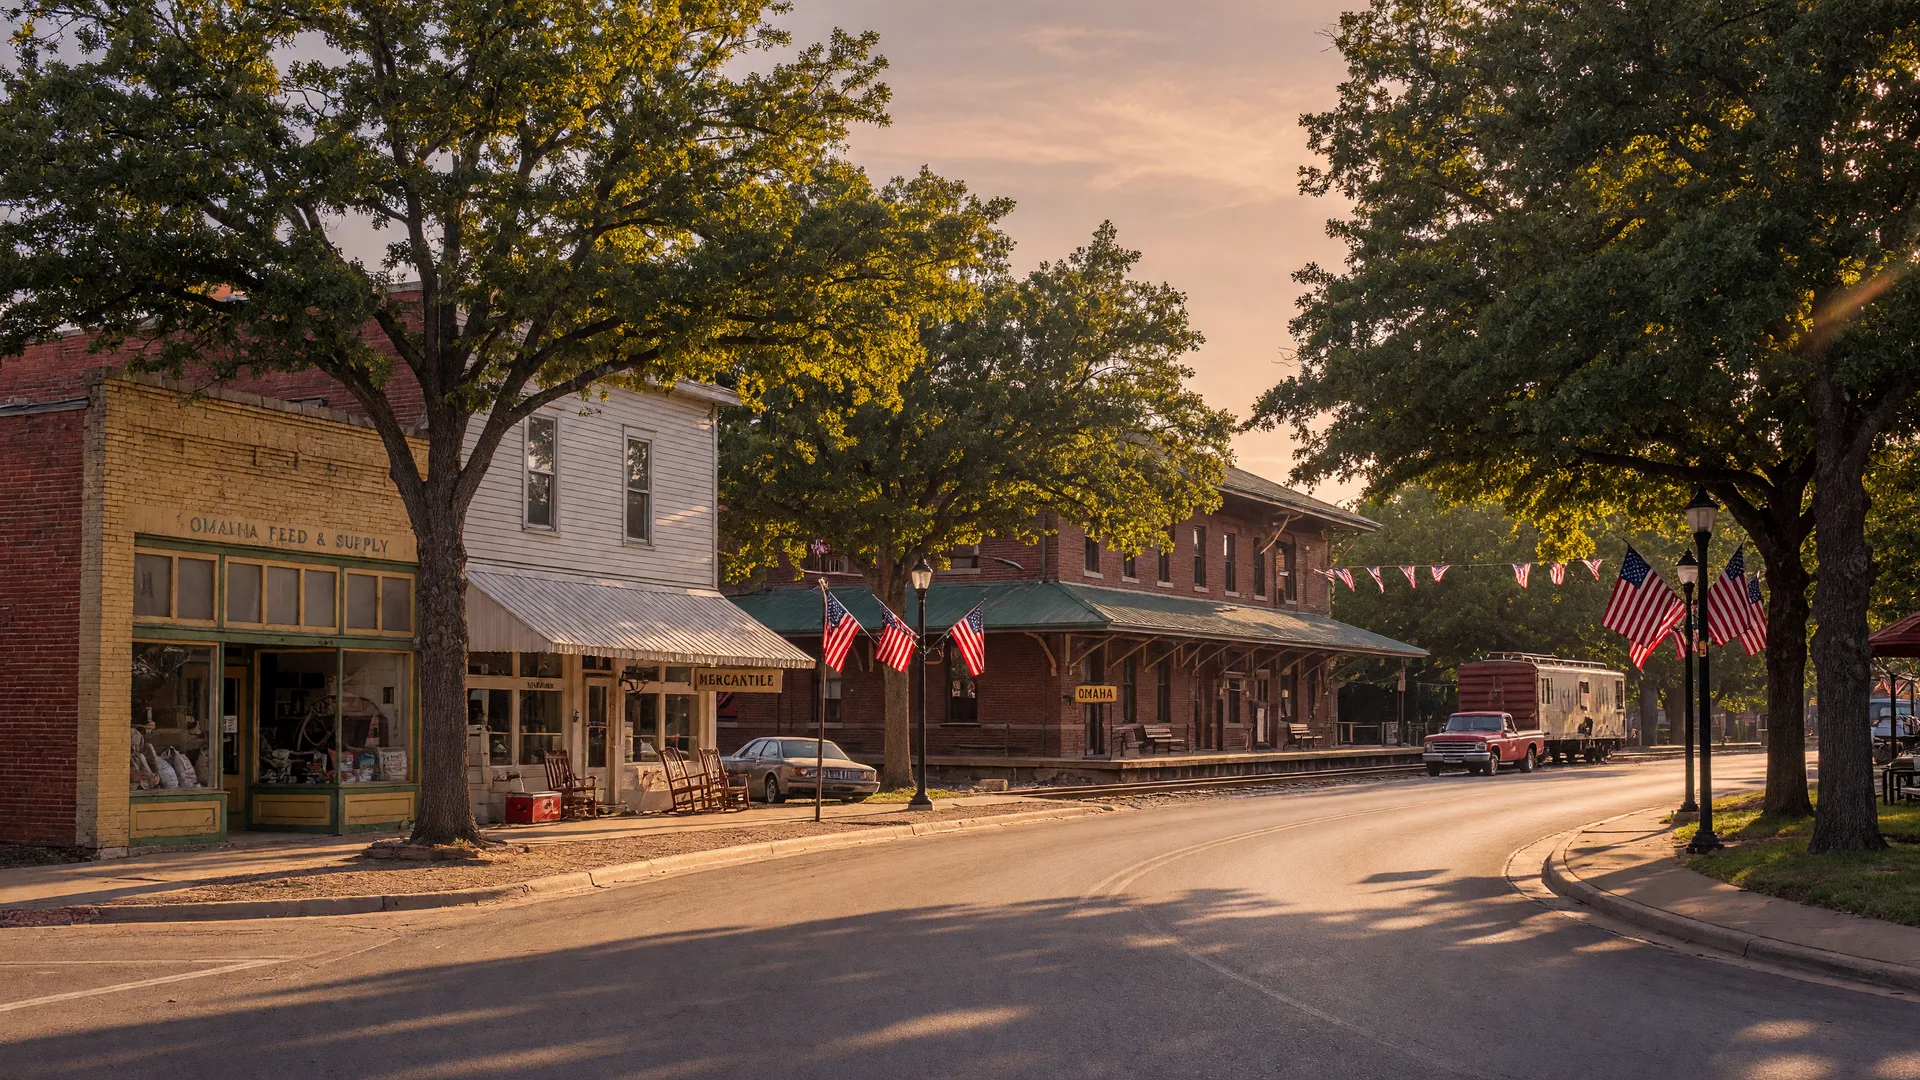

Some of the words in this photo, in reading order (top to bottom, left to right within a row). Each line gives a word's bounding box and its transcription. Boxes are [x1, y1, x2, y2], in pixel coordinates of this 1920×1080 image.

[269, 526, 308, 545] FEED
[316, 533, 326, 547] &
[336, 534, 389, 554] SUPPLY
[699, 673, 774, 687] MERCANTILE
[1078, 688, 1113, 699] OMAHA
